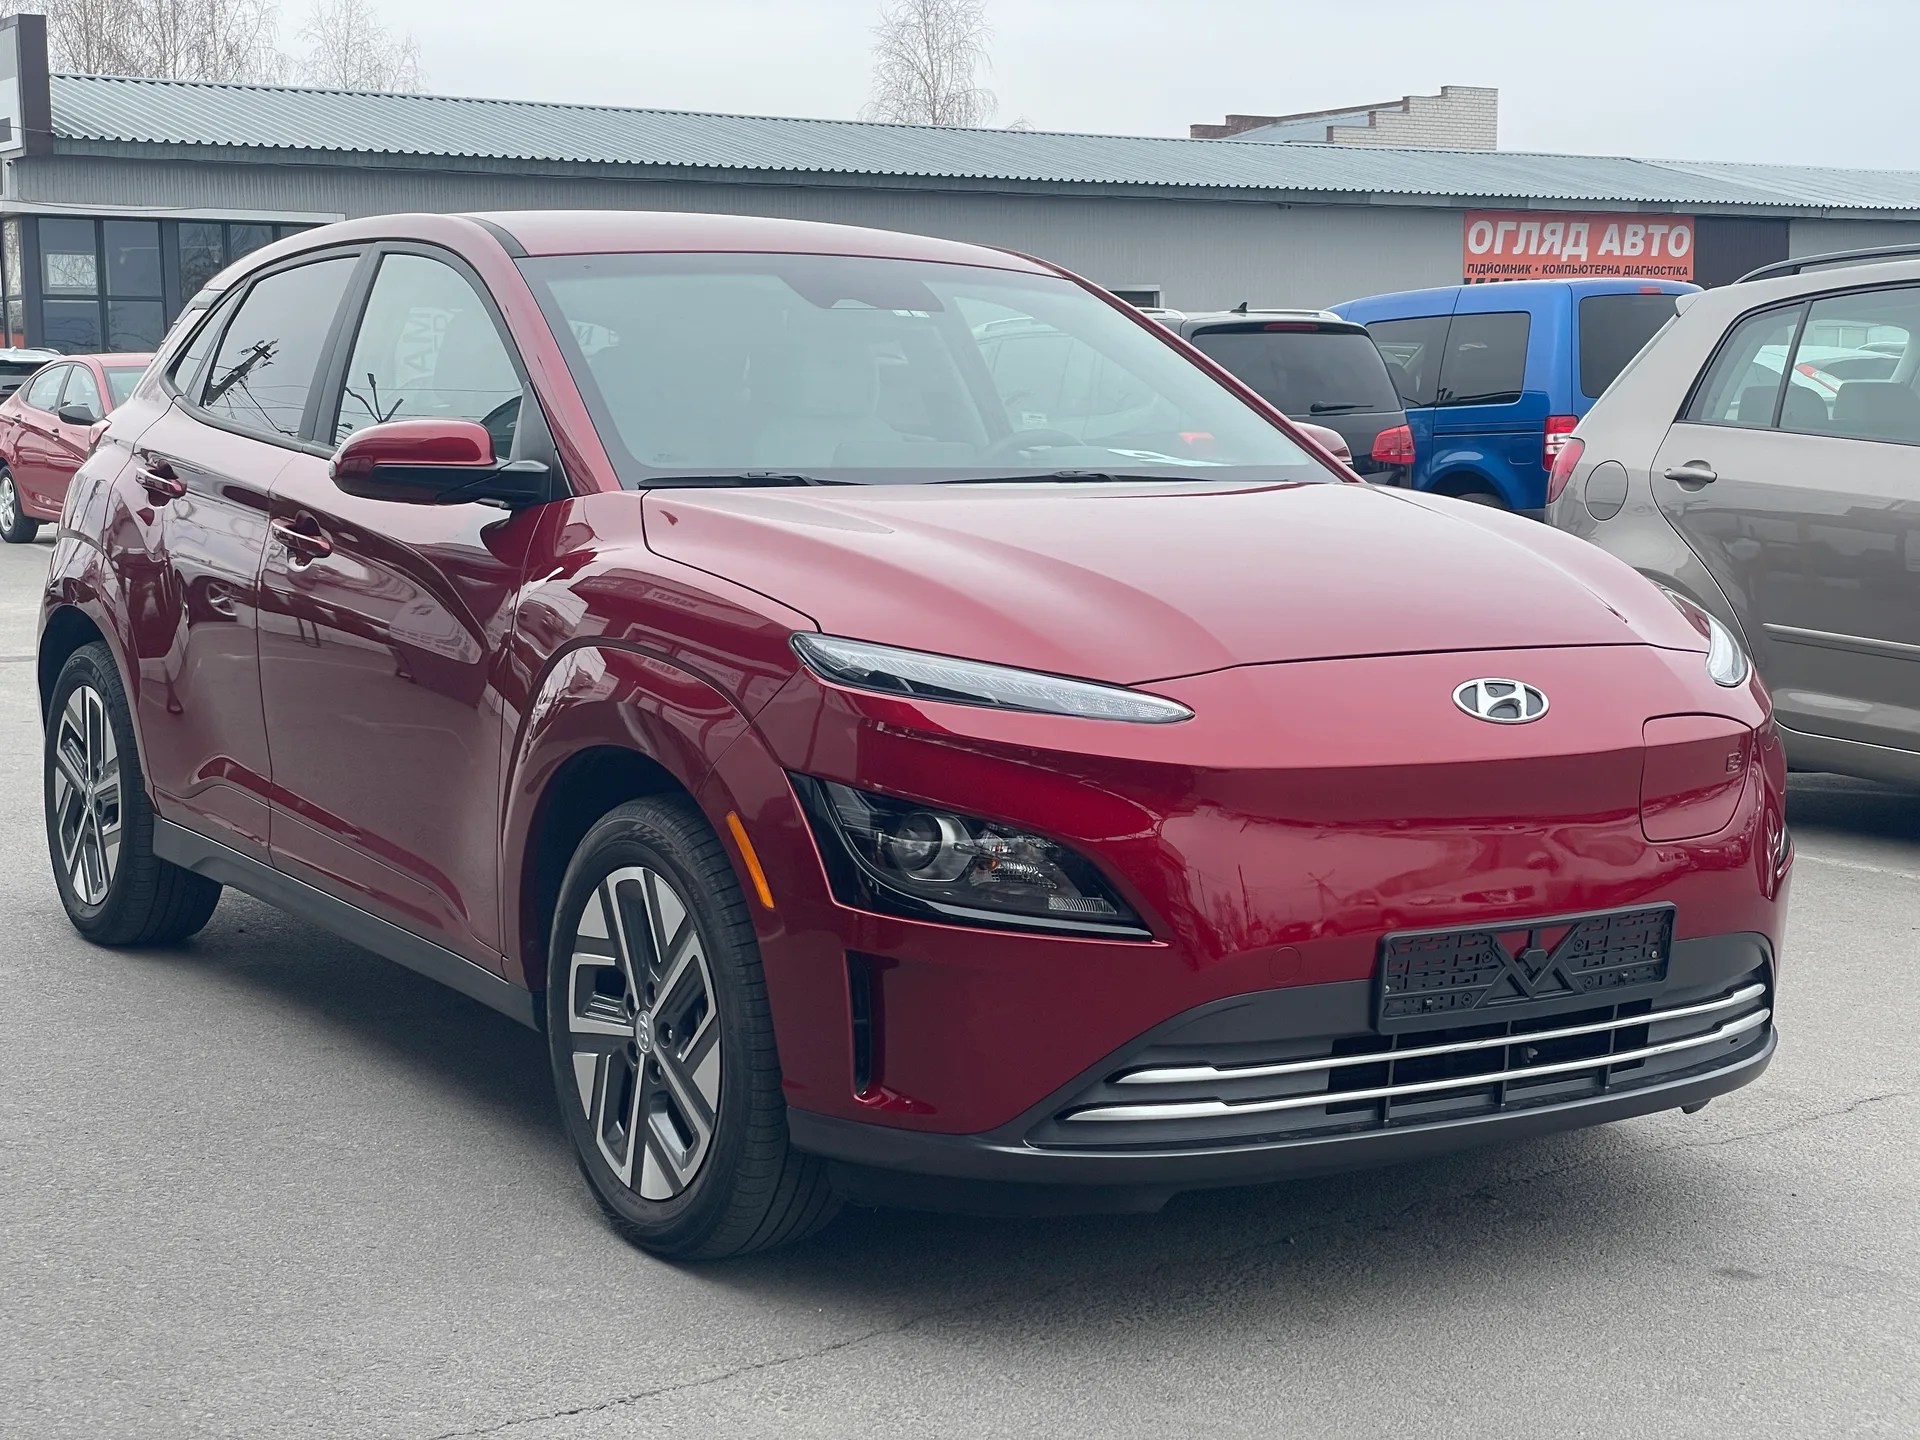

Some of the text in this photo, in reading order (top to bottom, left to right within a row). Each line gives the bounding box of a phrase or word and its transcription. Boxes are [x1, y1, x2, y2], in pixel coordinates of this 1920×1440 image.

[1468, 221, 1691, 261] ОГЛЯД АВТО
[1467, 262, 1688, 277] ПІДЙОМНИК КОМПЬЮТЕРНА ДІАГНОСТІКА
